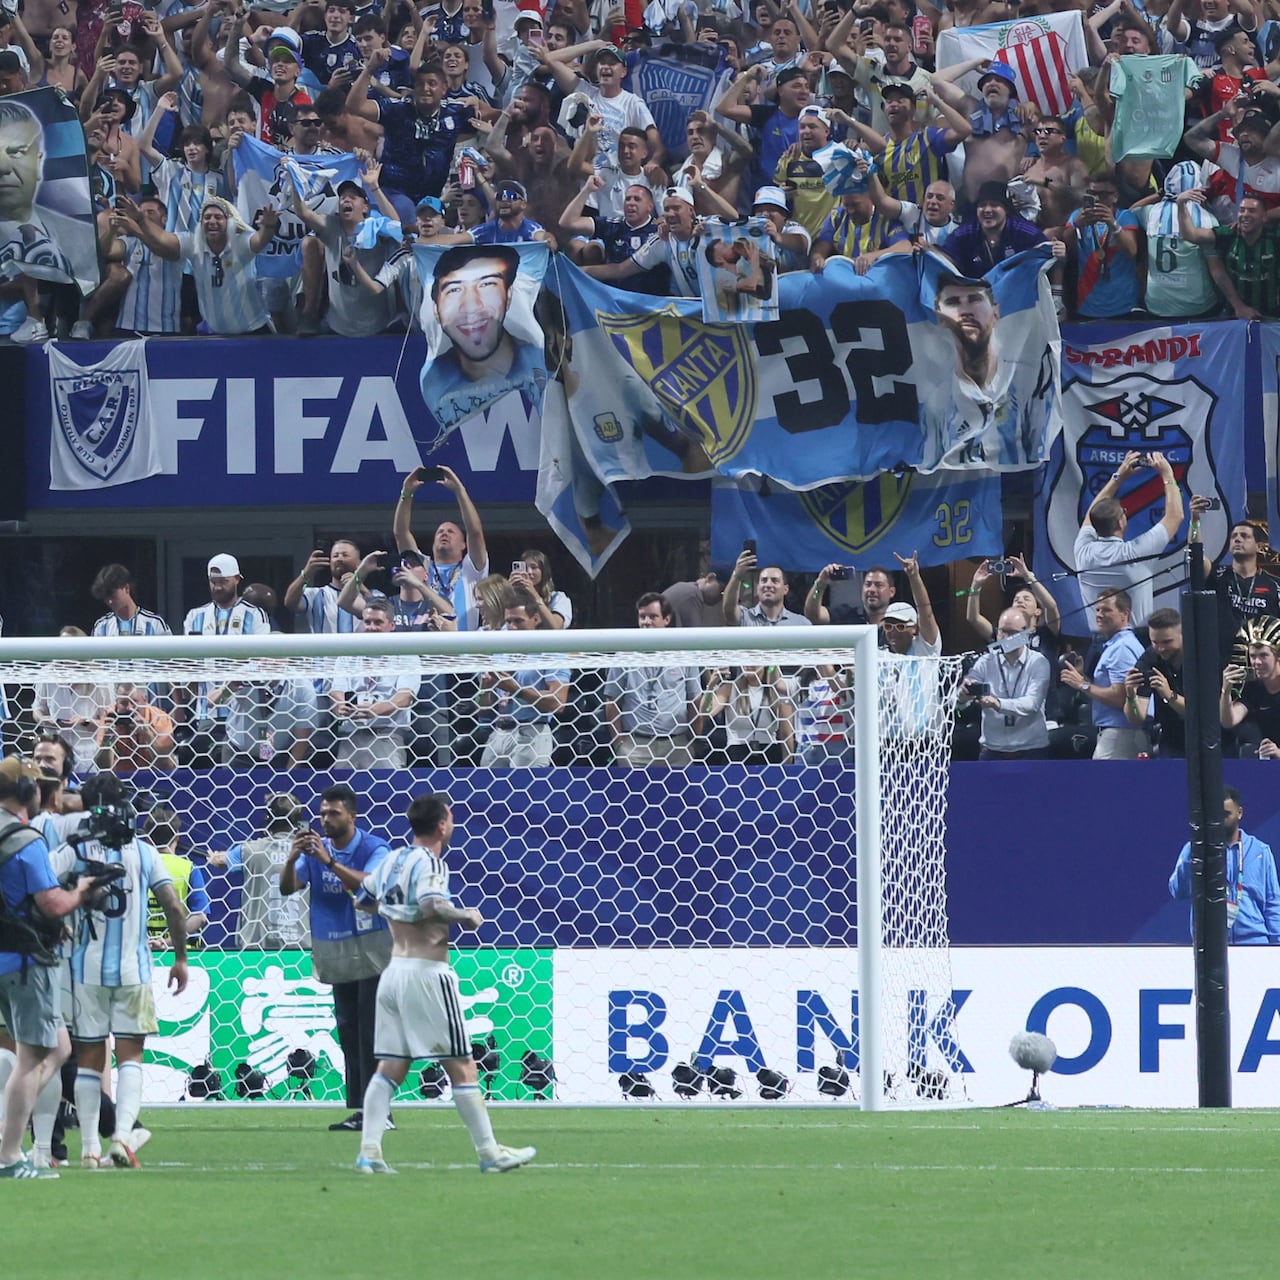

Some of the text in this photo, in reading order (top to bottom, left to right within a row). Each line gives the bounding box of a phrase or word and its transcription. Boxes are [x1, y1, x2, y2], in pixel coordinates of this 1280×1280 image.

[1156, 237, 1179, 274] 6
[72, 373, 123, 392] REGINA
[755, 299, 920, 435] 32
[158, 376, 425, 477] FIFA
[932, 499, 974, 548] 32
[607, 988, 977, 1076] BANK
[1026, 986, 1196, 1076] OF
